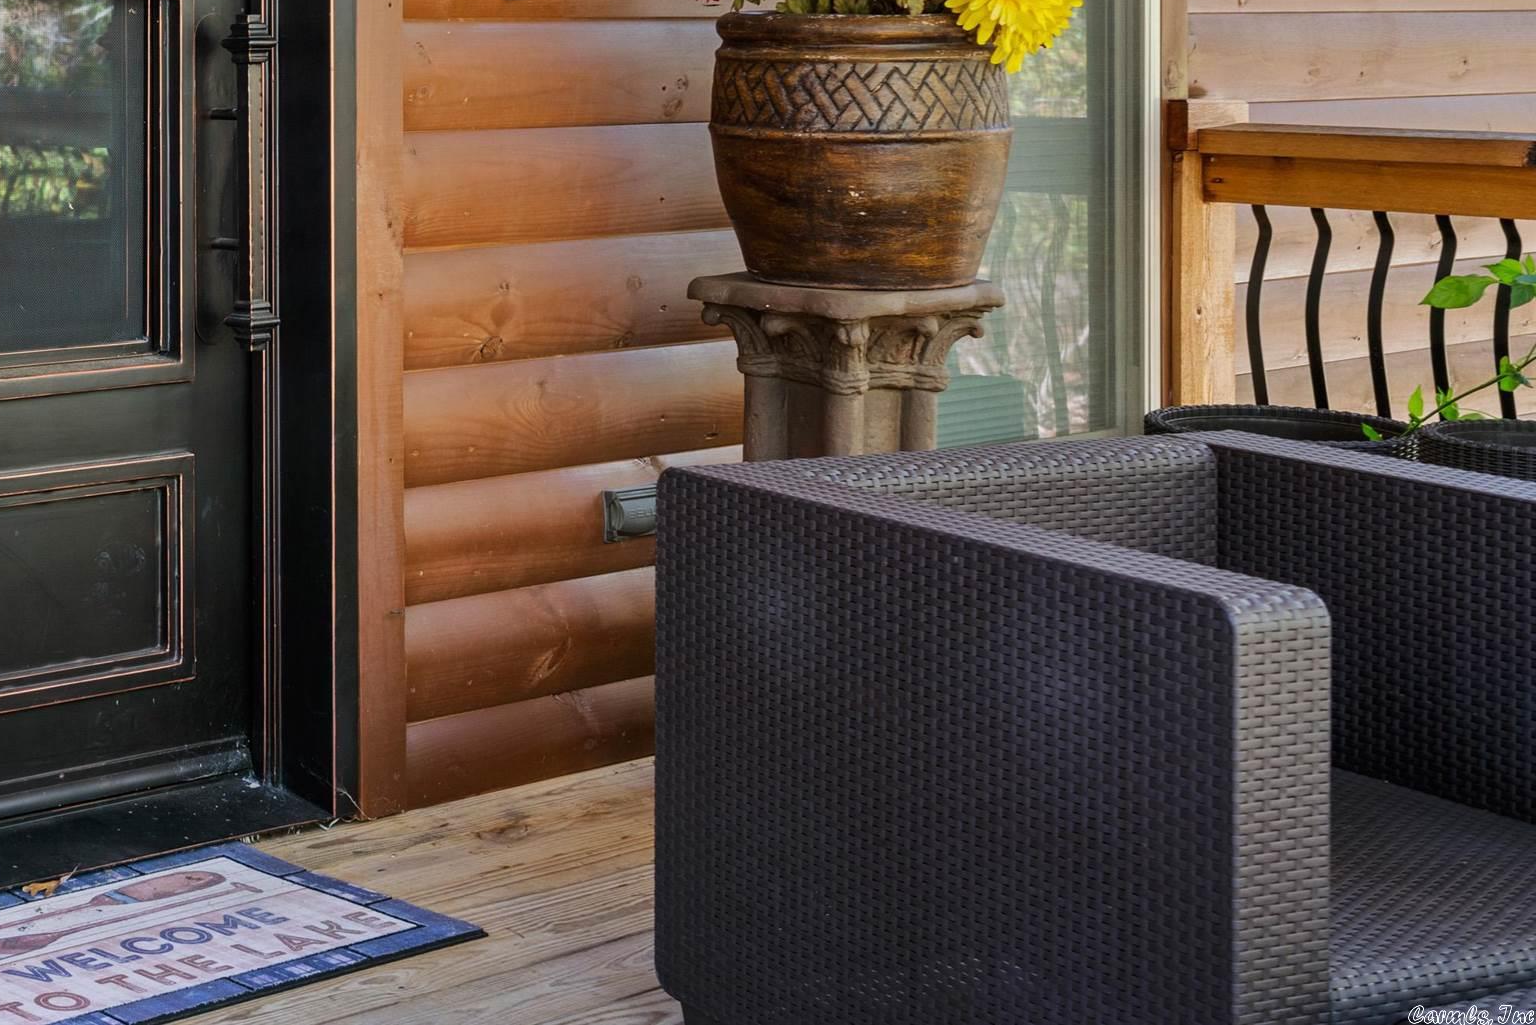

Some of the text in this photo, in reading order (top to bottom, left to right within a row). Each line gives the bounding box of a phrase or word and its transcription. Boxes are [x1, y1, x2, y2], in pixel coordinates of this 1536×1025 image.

[2, 907, 290, 983] WELCOME
[95, 953, 234, 994] THE
[231, 911, 398, 962] LAKE
